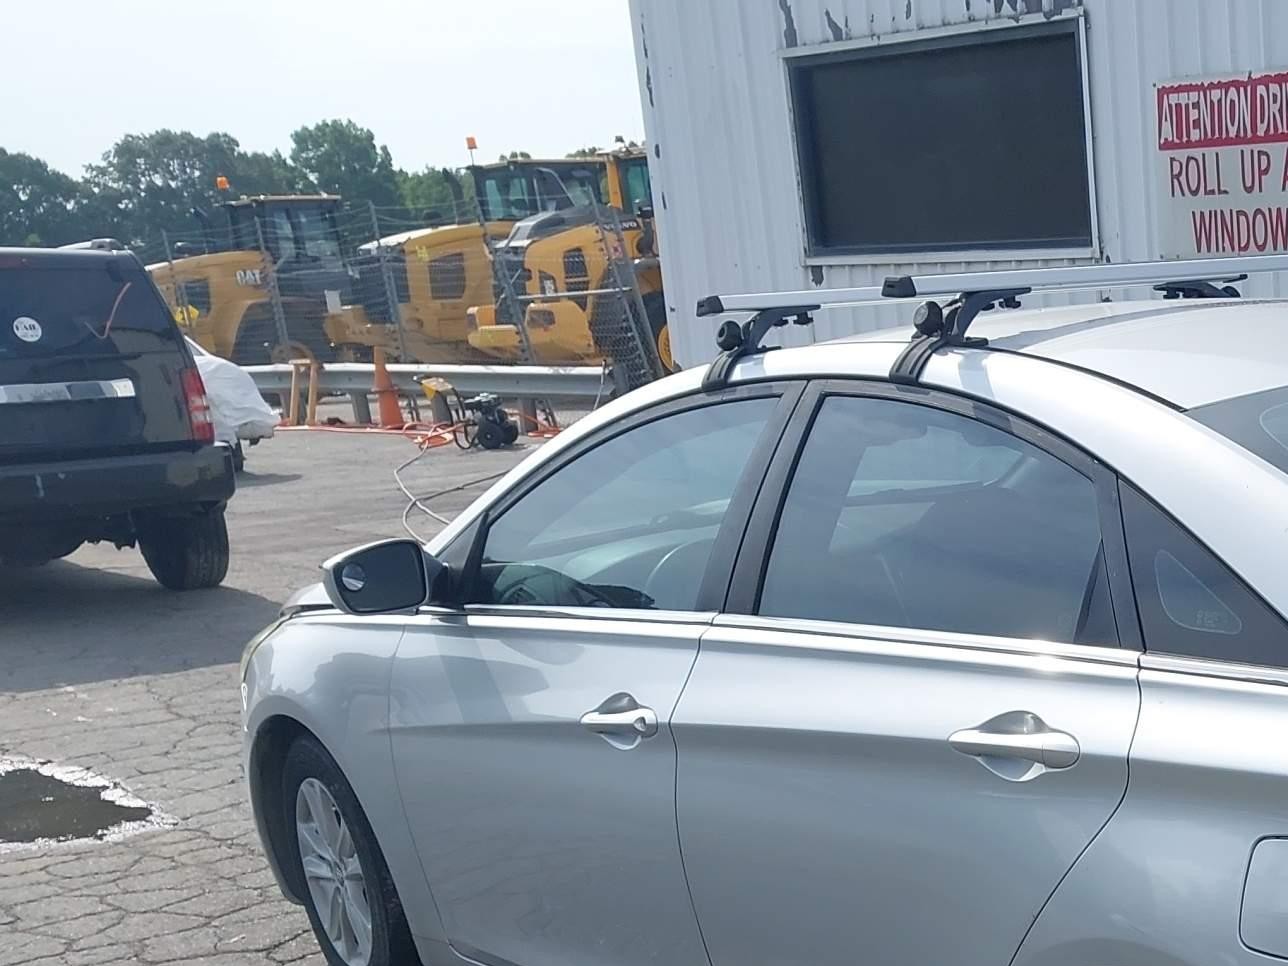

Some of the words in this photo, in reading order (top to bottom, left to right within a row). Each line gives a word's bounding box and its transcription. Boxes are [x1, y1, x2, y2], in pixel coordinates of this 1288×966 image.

[1159, 85, 1253, 145] ATTENTION
[1169, 151, 1229, 198] ROLL
[1240, 148, 1271, 194] UP
[236, 269, 261, 286] CAT
